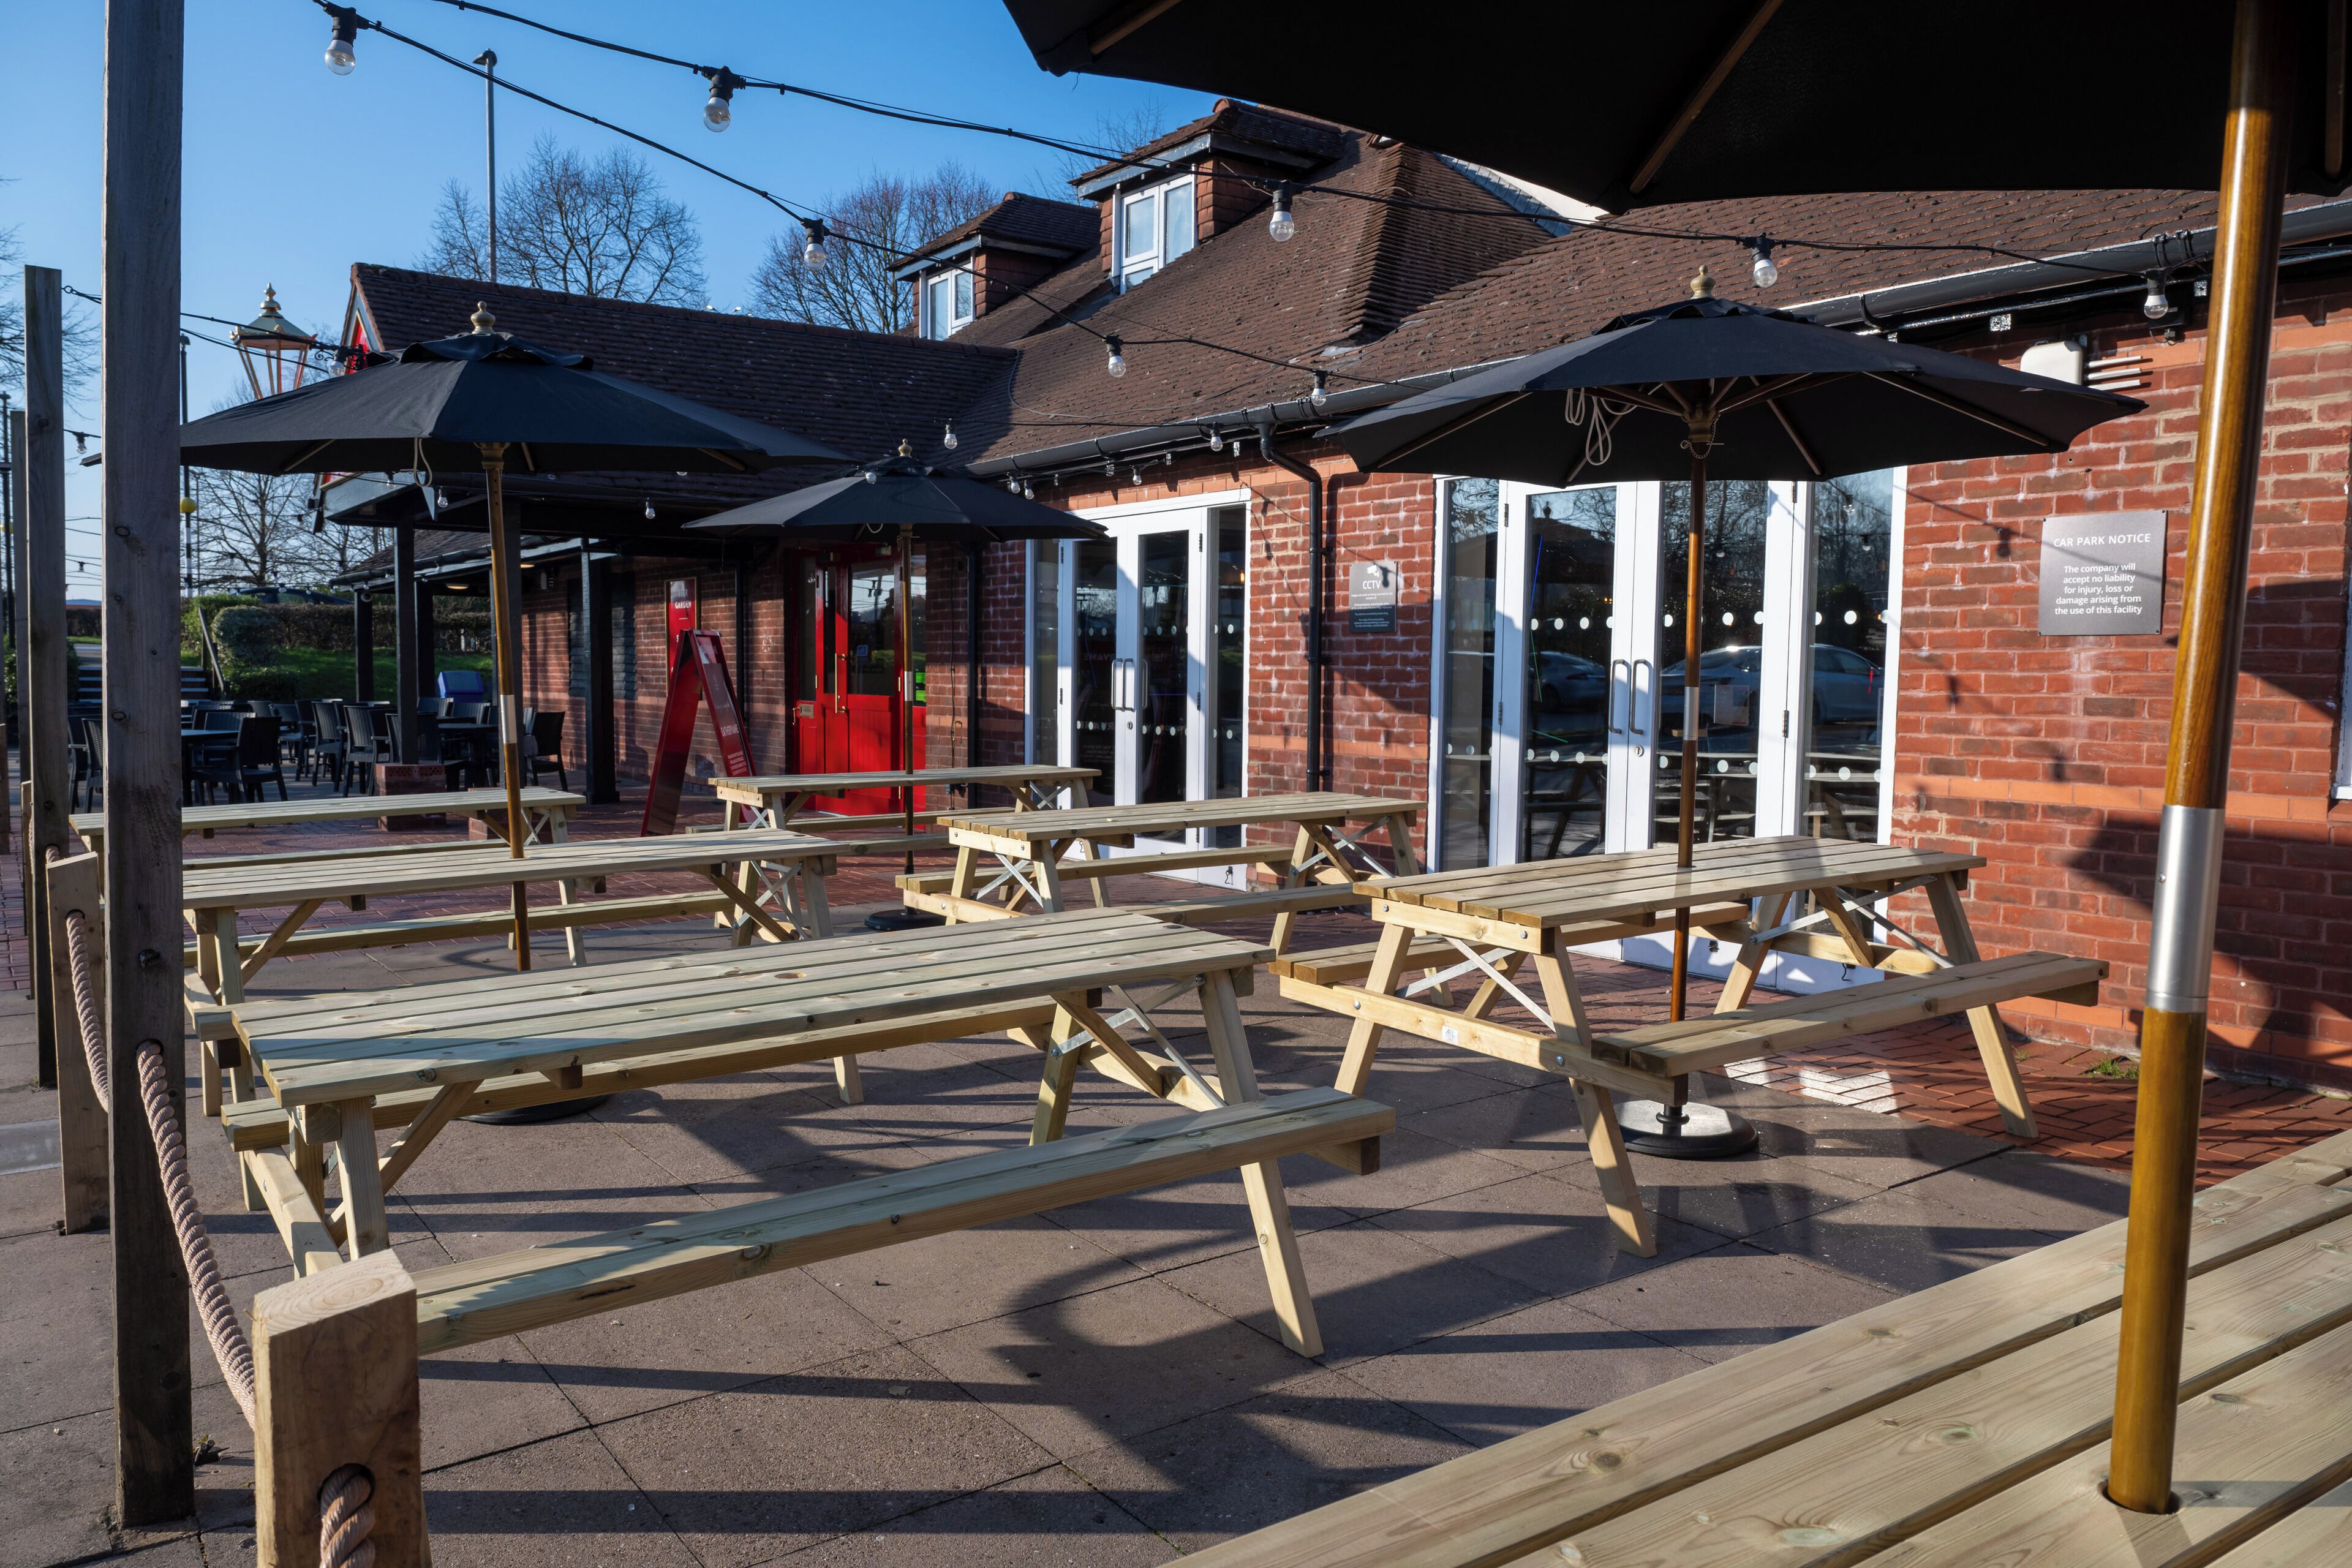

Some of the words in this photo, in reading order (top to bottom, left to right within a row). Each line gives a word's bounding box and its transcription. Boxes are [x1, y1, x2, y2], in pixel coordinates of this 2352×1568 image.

[2054, 538, 2073, 547] CAR
[2076, 536, 2105, 546] PARK
[2108, 533, 2151, 544] NOTICE
[2064, 565, 2079, 574] The
[2081, 564, 2119, 574] company
[2063, 576, 2090, 585] accept
[2105, 573, 2136, 583] liability
[1363, 580, 1381, 589] CCTV
[2078, 586, 2103, 595] injury,
[2105, 584, 2122, 593] loss
[675, 601, 692, 609] GARDEN
[2056, 597, 2089, 605] damage
[2090, 595, 2119, 605] arising
[2096, 605, 2113, 614] this
[2113, 605, 2143, 615] facility
[721, 724, 739, 737] EATHERVANE
